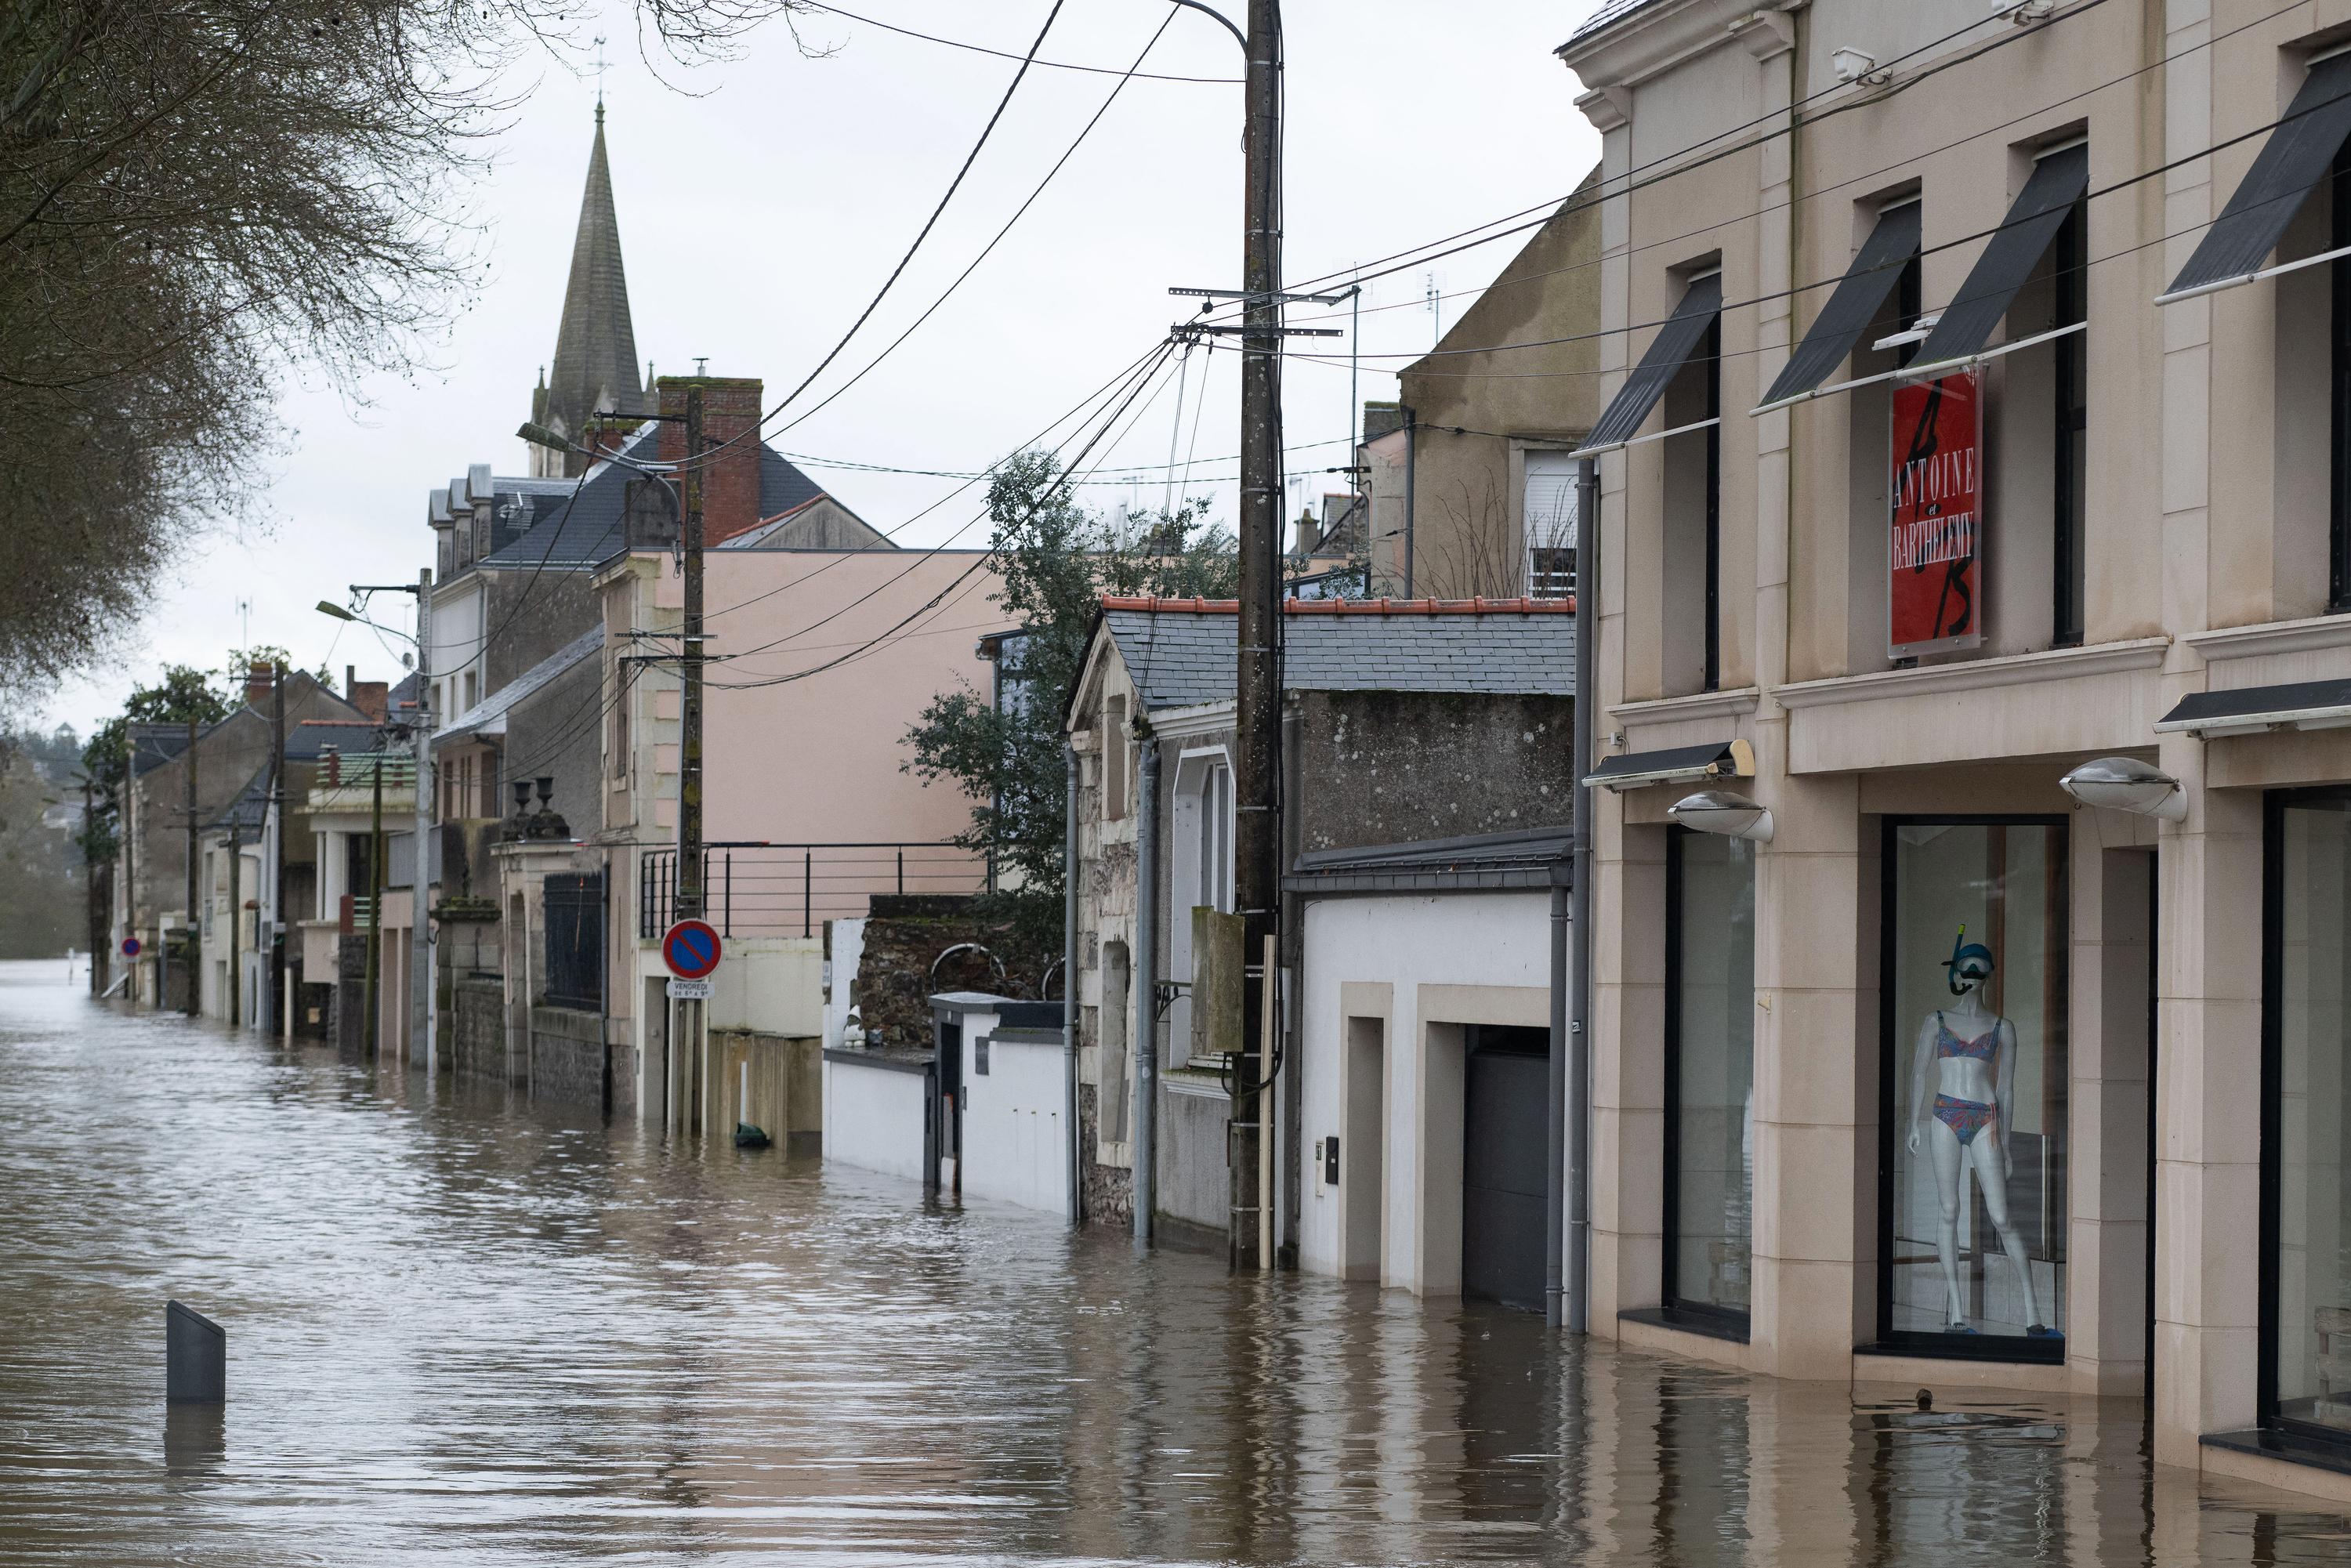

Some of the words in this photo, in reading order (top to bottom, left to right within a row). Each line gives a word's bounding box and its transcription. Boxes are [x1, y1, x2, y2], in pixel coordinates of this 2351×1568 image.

[1893, 447, 1974, 509] ANTOINE
[1929, 503, 1937, 516] et
[1893, 511, 1974, 570] BARTHELEMY
